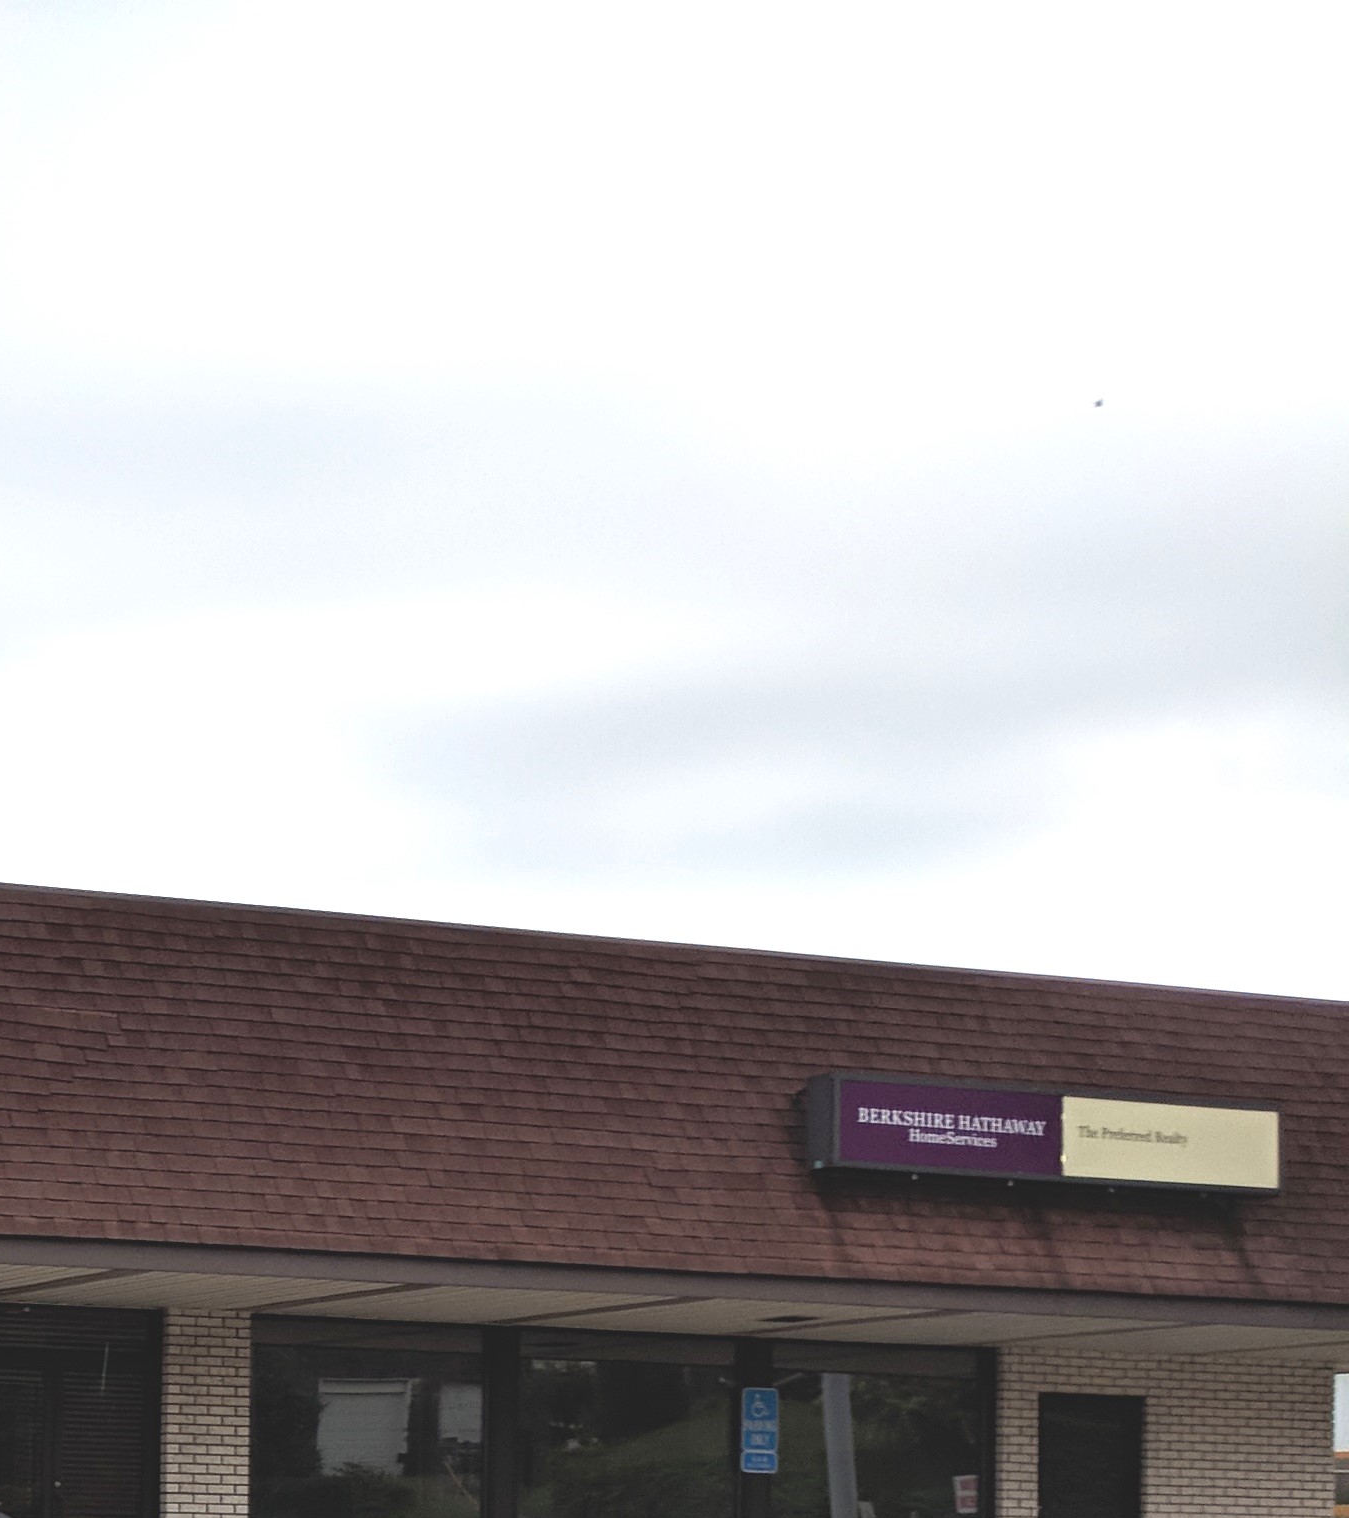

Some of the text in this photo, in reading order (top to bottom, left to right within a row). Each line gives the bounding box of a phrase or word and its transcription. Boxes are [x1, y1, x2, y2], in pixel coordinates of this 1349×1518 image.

[857, 1107, 1047, 1137] BERKSHIRE HATHAWAY
[908, 1127, 998, 1148] HomeServices
